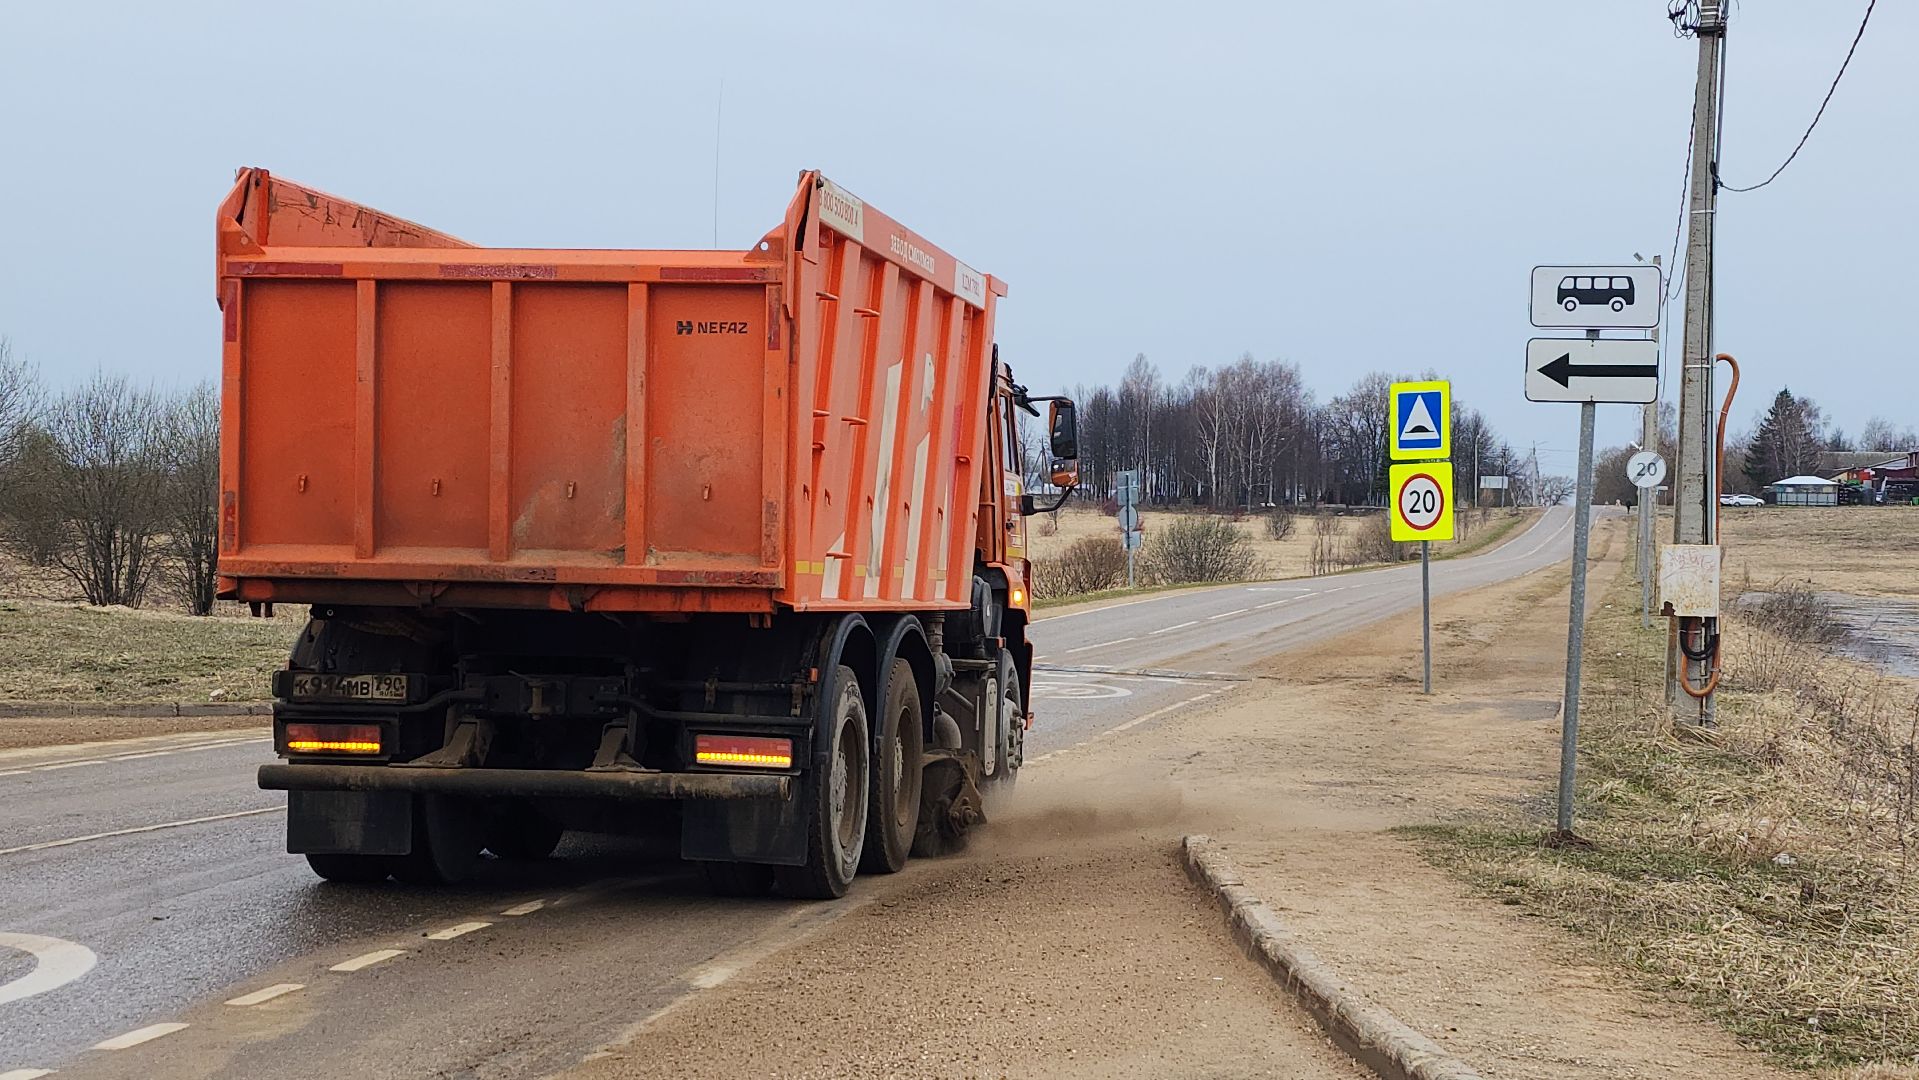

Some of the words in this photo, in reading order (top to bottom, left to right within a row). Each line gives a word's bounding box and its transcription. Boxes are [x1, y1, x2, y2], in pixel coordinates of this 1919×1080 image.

[697, 321, 748, 334] NEFAZ
[1636, 462, 1657, 476] 20
[1409, 489, 1435, 513] 20
